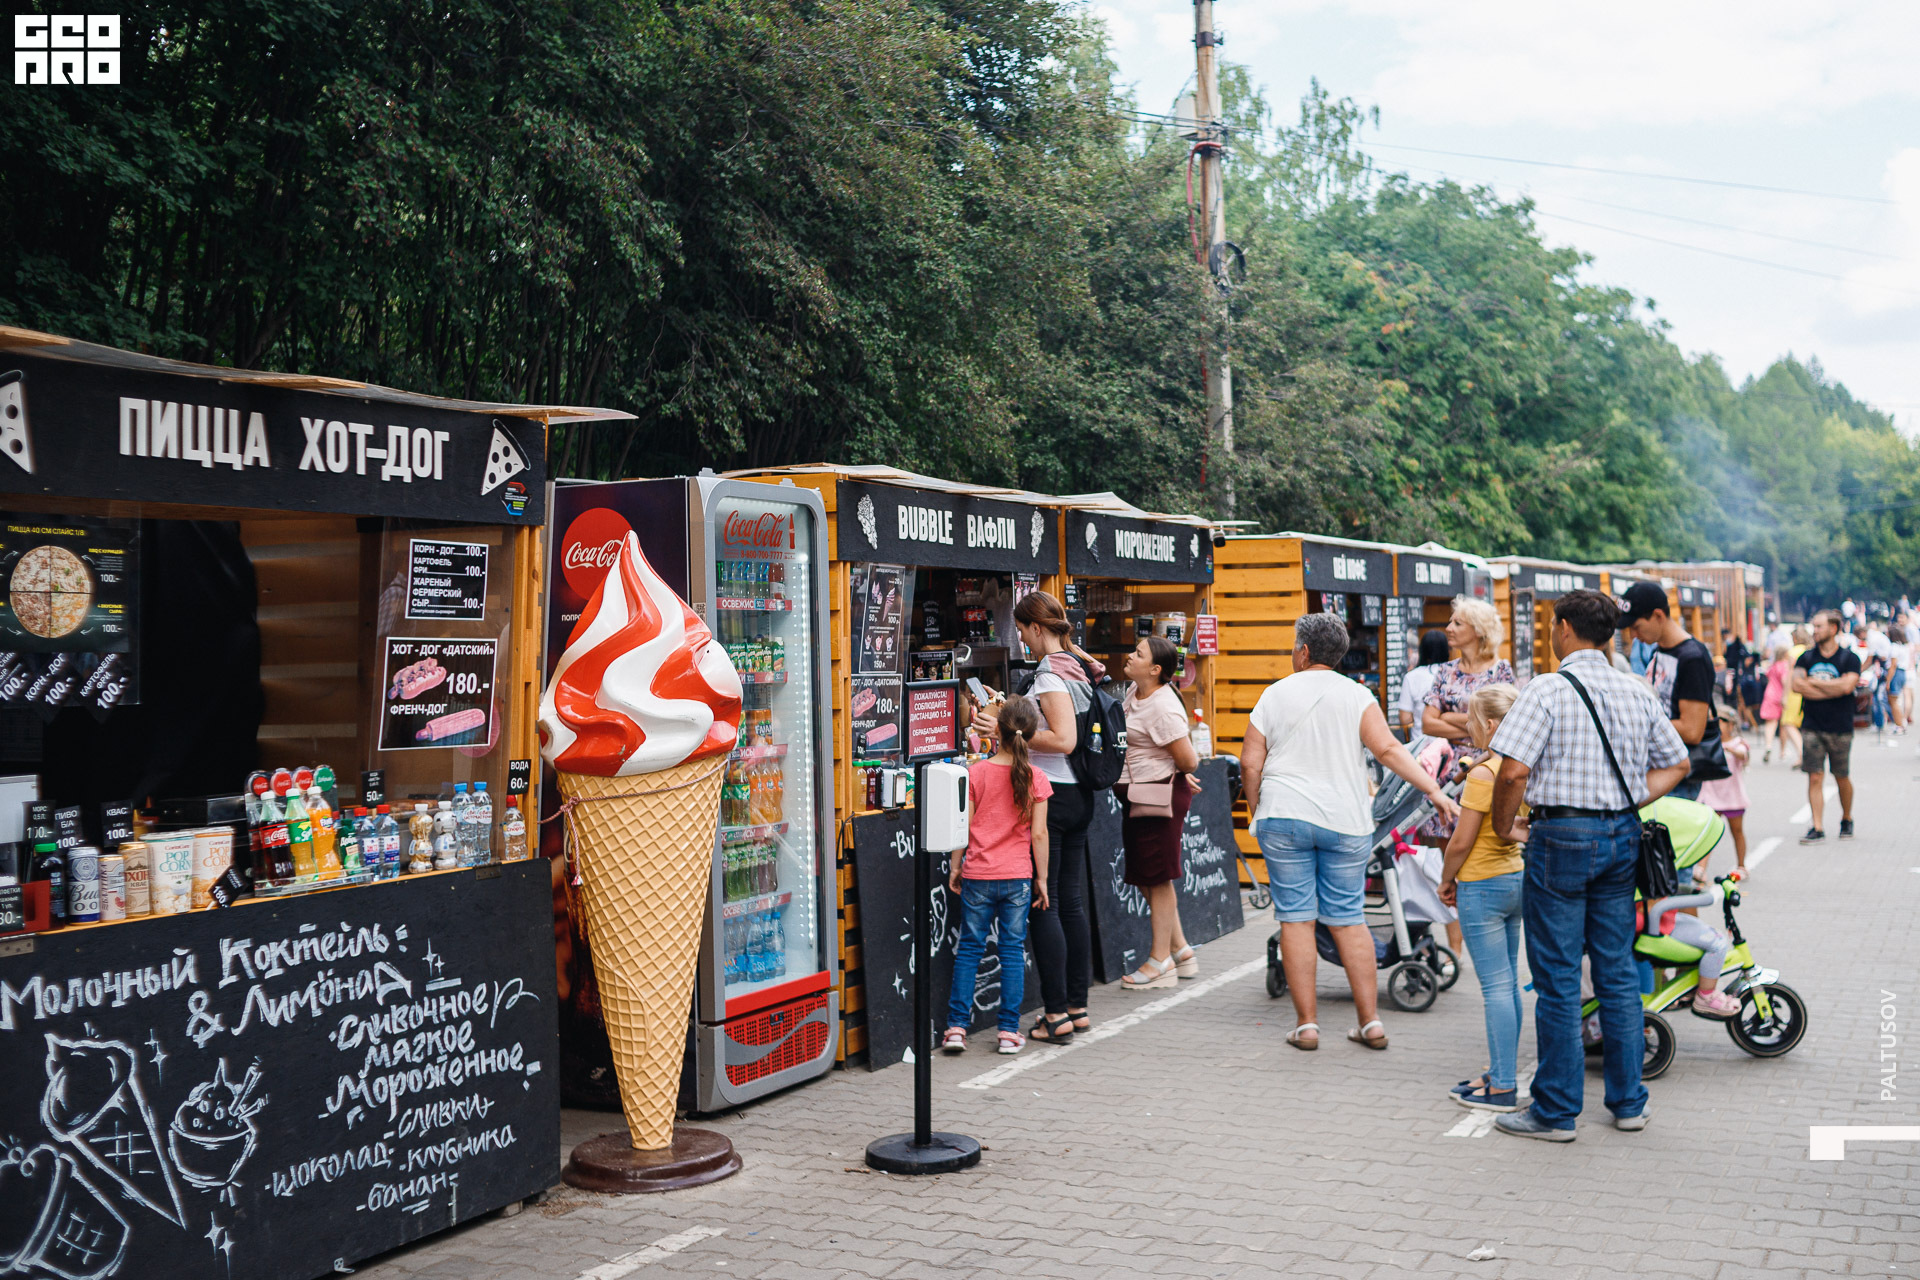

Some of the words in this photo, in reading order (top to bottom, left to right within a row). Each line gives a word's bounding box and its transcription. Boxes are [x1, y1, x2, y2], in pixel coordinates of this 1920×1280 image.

[119, 396, 271, 471] ПИЦЦА
[299, 416, 450, 483] ХОТ-ДОГ
[724, 509, 786, 548] Coca-Cola
[897, 504, 954, 545] BUBBLE
[966, 513, 1016, 551] ВАФЛИ
[414, 544, 435, 554] КОРН
[440, 546, 456, 556] ДОГ
[465, 545, 486, 557] 100.-
[1114, 528, 1176, 563] МОРОЖЕНОЕ
[565, 539, 623, 570] Coca-Co
[741, 550, 783, 560] 8-800-700-7777
[413, 557, 452, 567] КАРТОФЕЛЬ
[413, 566, 428, 574] ФРИ
[465, 566, 486, 577] 100.-
[413, 577, 452, 587] ЖАРЕНЫЙ
[412, 588, 462, 598] ФЕРМЕРСКИЙ
[411, 598, 429, 607] СЫР
[463, 598, 484, 609] 100.-
[722, 599, 754, 608] ОСВЕЖИС
[391, 643, 414, 655] ХОТ
[420, 644, 441, 657] ДОГ
[442, 643, 495, 657] «ДАТСКИЙ»
[446, 673, 490, 694] 180.-
[914, 690, 948, 701] ПОЖАЛУЙСТА!
[390, 703, 447, 716] ФРЕНЧ-ДОГ
[876, 698, 899, 714] 180.-
[914, 700, 947, 711] СОБЛЮДАЙТЕ
[851, 719, 876, 728] РЕНЧ-ДОГ
[511, 761, 529, 771] ВОДА
[510, 778, 528, 789] 60.-
[366, 790, 383, 802] 50.-
[55, 810, 78, 820] ПИВО
[107, 807, 128, 817] КВАС
[106, 830, 134, 841] 100.-
[166, 850, 190, 863] POP
[0, 947, 198, 1030] Молочный
